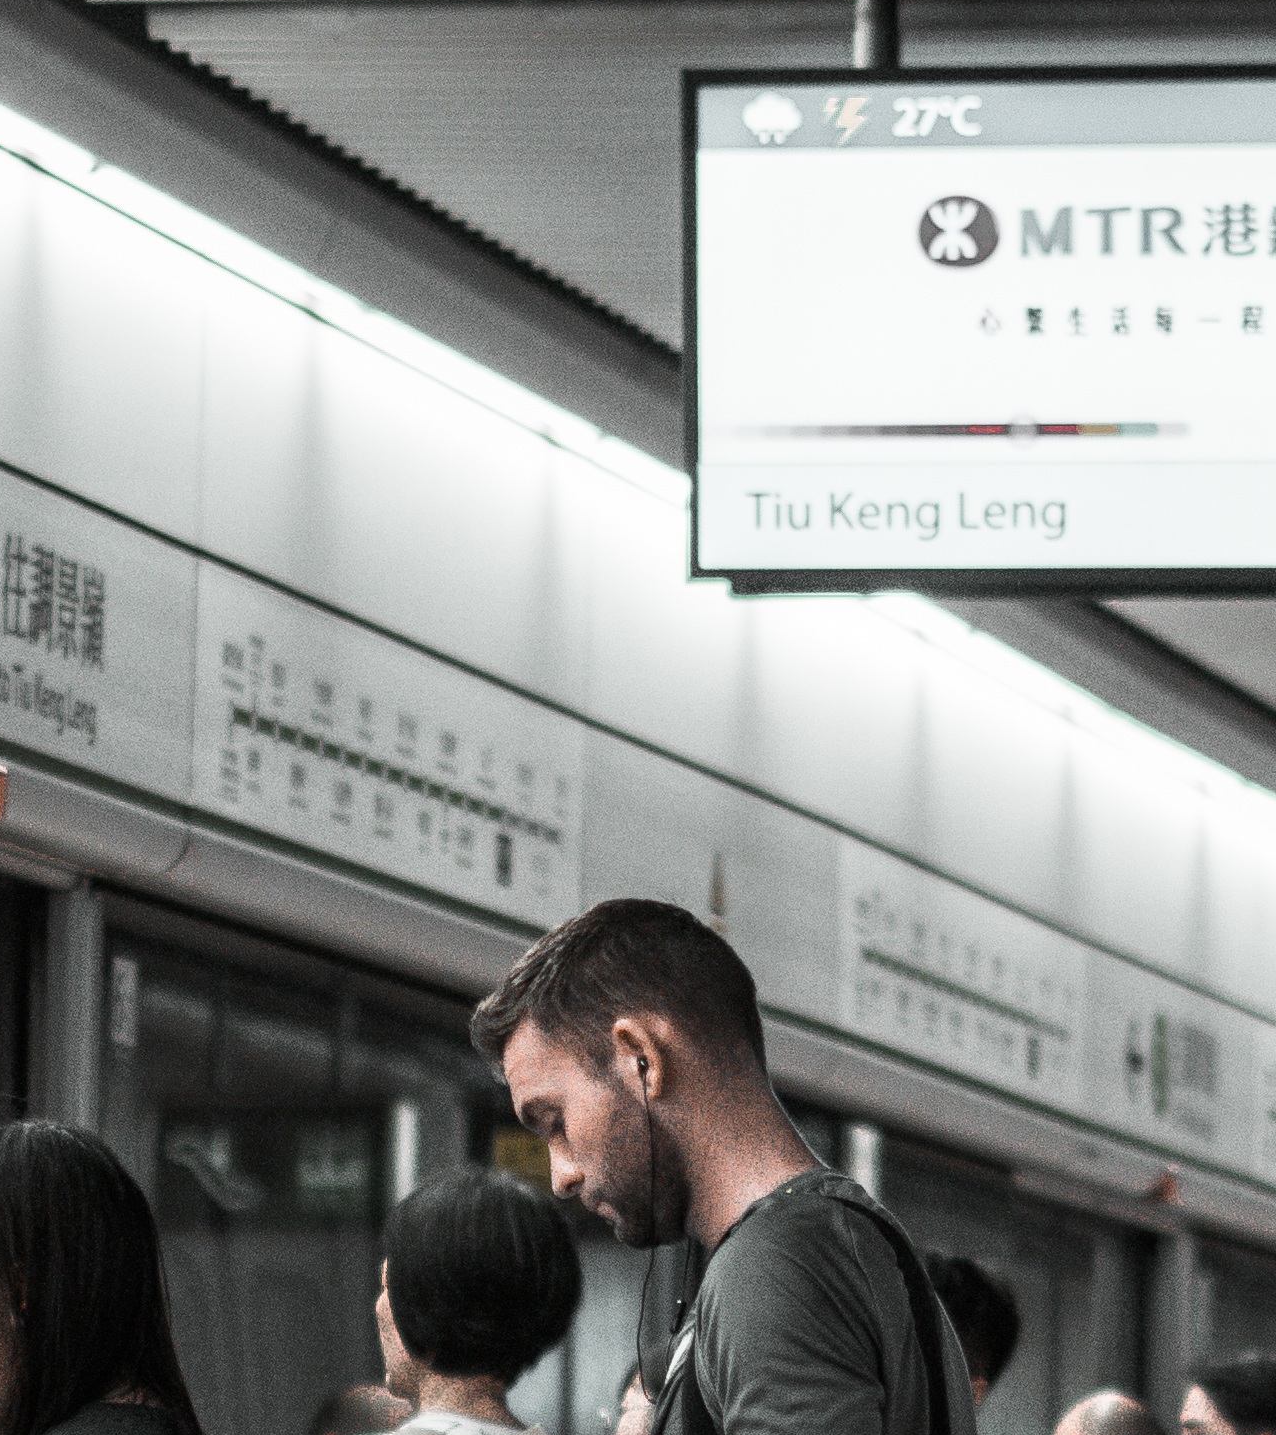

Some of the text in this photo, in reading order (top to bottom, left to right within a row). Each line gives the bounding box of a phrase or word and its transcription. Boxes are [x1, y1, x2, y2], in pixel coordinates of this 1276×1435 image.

[1018, 205, 1188, 258] MTR
[745, 491, 1068, 541] Tiu Keng Leng
